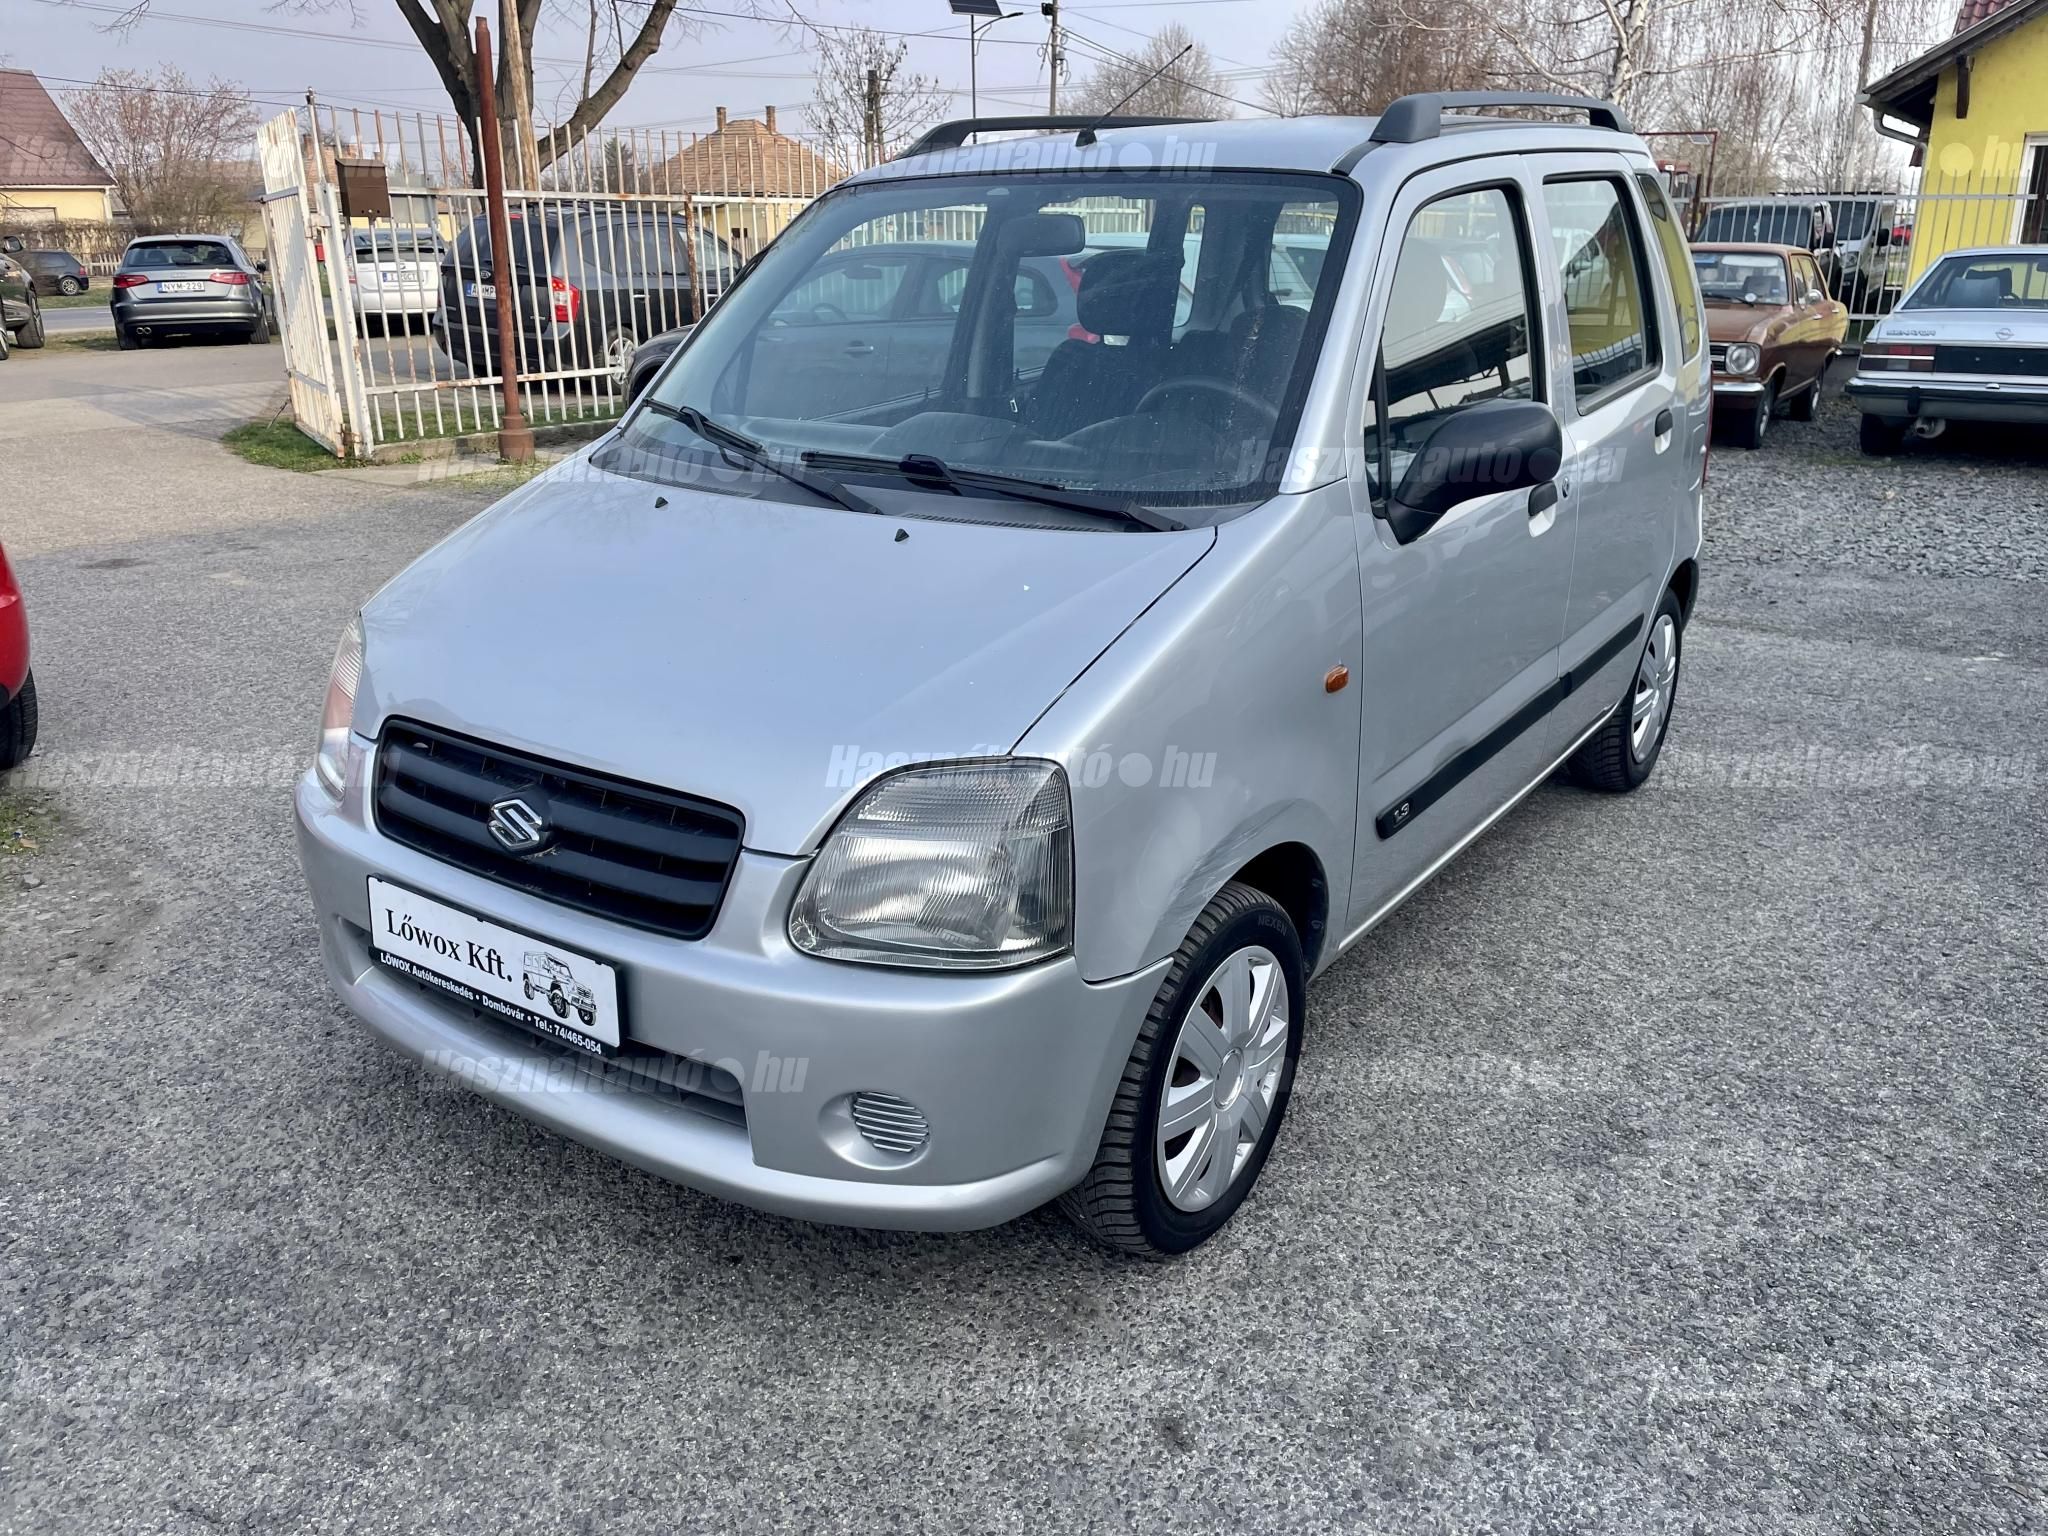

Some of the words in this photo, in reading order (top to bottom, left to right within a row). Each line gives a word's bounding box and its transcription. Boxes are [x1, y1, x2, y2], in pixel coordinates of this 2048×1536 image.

[164, 282, 202, 290] NYM-229
[385, 908, 461, 962] Lőwox
[466, 940, 513, 983] Kft.
[1257, 914, 1288, 937] NEXEN
[412, 965, 474, 1000] Autókereskedés
[482, 994, 525, 1022] Dombóvár
[533, 1015, 553, 1032] Tel.:
[554, 1024, 602, 1055] 74/465-054
